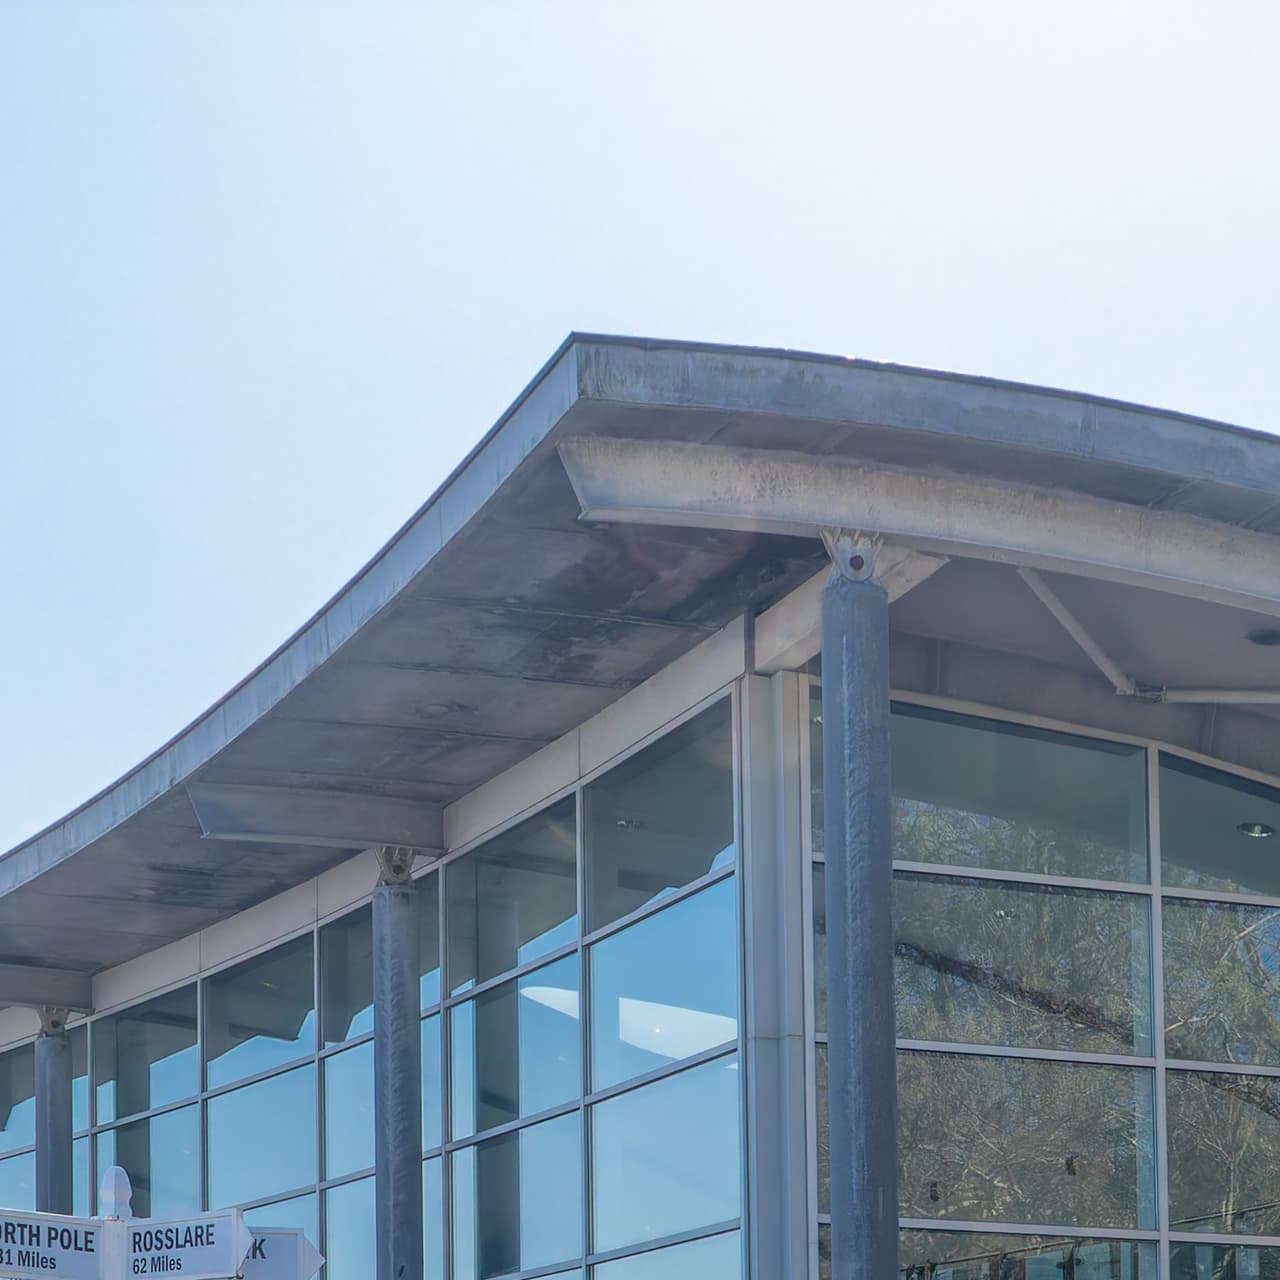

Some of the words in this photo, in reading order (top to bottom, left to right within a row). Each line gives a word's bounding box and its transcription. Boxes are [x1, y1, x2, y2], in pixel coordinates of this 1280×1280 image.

[47, 1226, 95, 1254] POLE
[132, 1223, 215, 1254] ROSSLARE
[16, 1249, 57, 1270] Miles
[132, 1257, 148, 1275] 62
[150, 1255, 183, 1274] Miles
